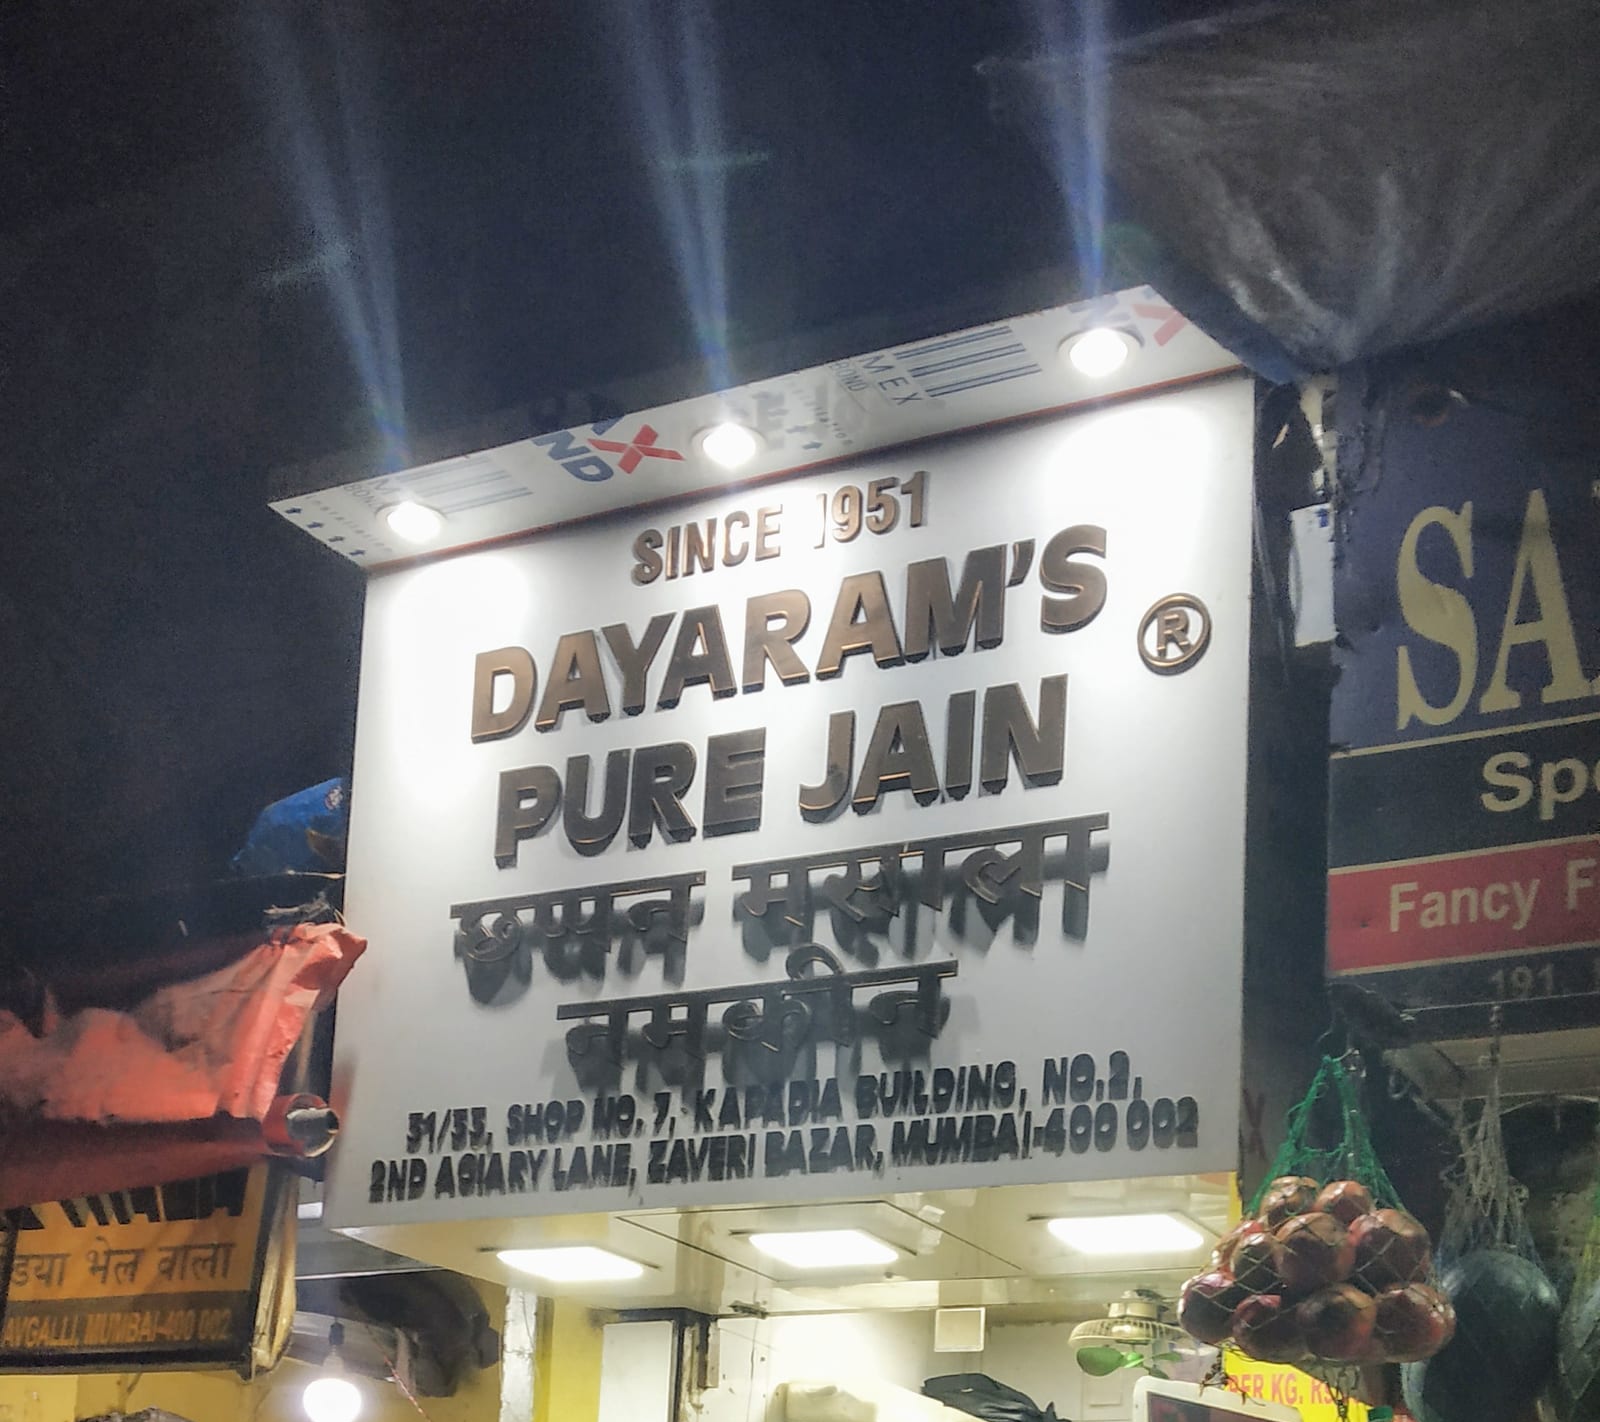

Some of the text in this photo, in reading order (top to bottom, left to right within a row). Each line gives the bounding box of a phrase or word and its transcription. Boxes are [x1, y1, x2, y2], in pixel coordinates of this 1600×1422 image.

[631, 470, 931, 587] SINCE 1951
[470, 525, 1108, 744] DAYARAM'S
[1397, 487, 1600, 731] SA
[493, 673, 1069, 869] PURE JAIN
[1480, 752, 1600, 820] Sp
[731, 811, 1110, 929] मसाला
[1389, 878, 1540, 931] Fancy
[556, 942, 959, 1069] नमकीन
[369, 1158, 427, 1204] 2ND
[435, 1147, 548, 1200] AGIARY
[551, 1141, 639, 1197] LANE,
[647, 1130, 756, 1185] ZAVERI
[765, 1122, 885, 1177] BAZAR,
[1126, 1095, 1199, 1152] 002
[506, 1098, 586, 1147] SHOP
[855, 1059, 1029, 1120] BUILDING,
[87, 1235, 145, 1286] भेल
[157, 1242, 237, 1282] वाला
